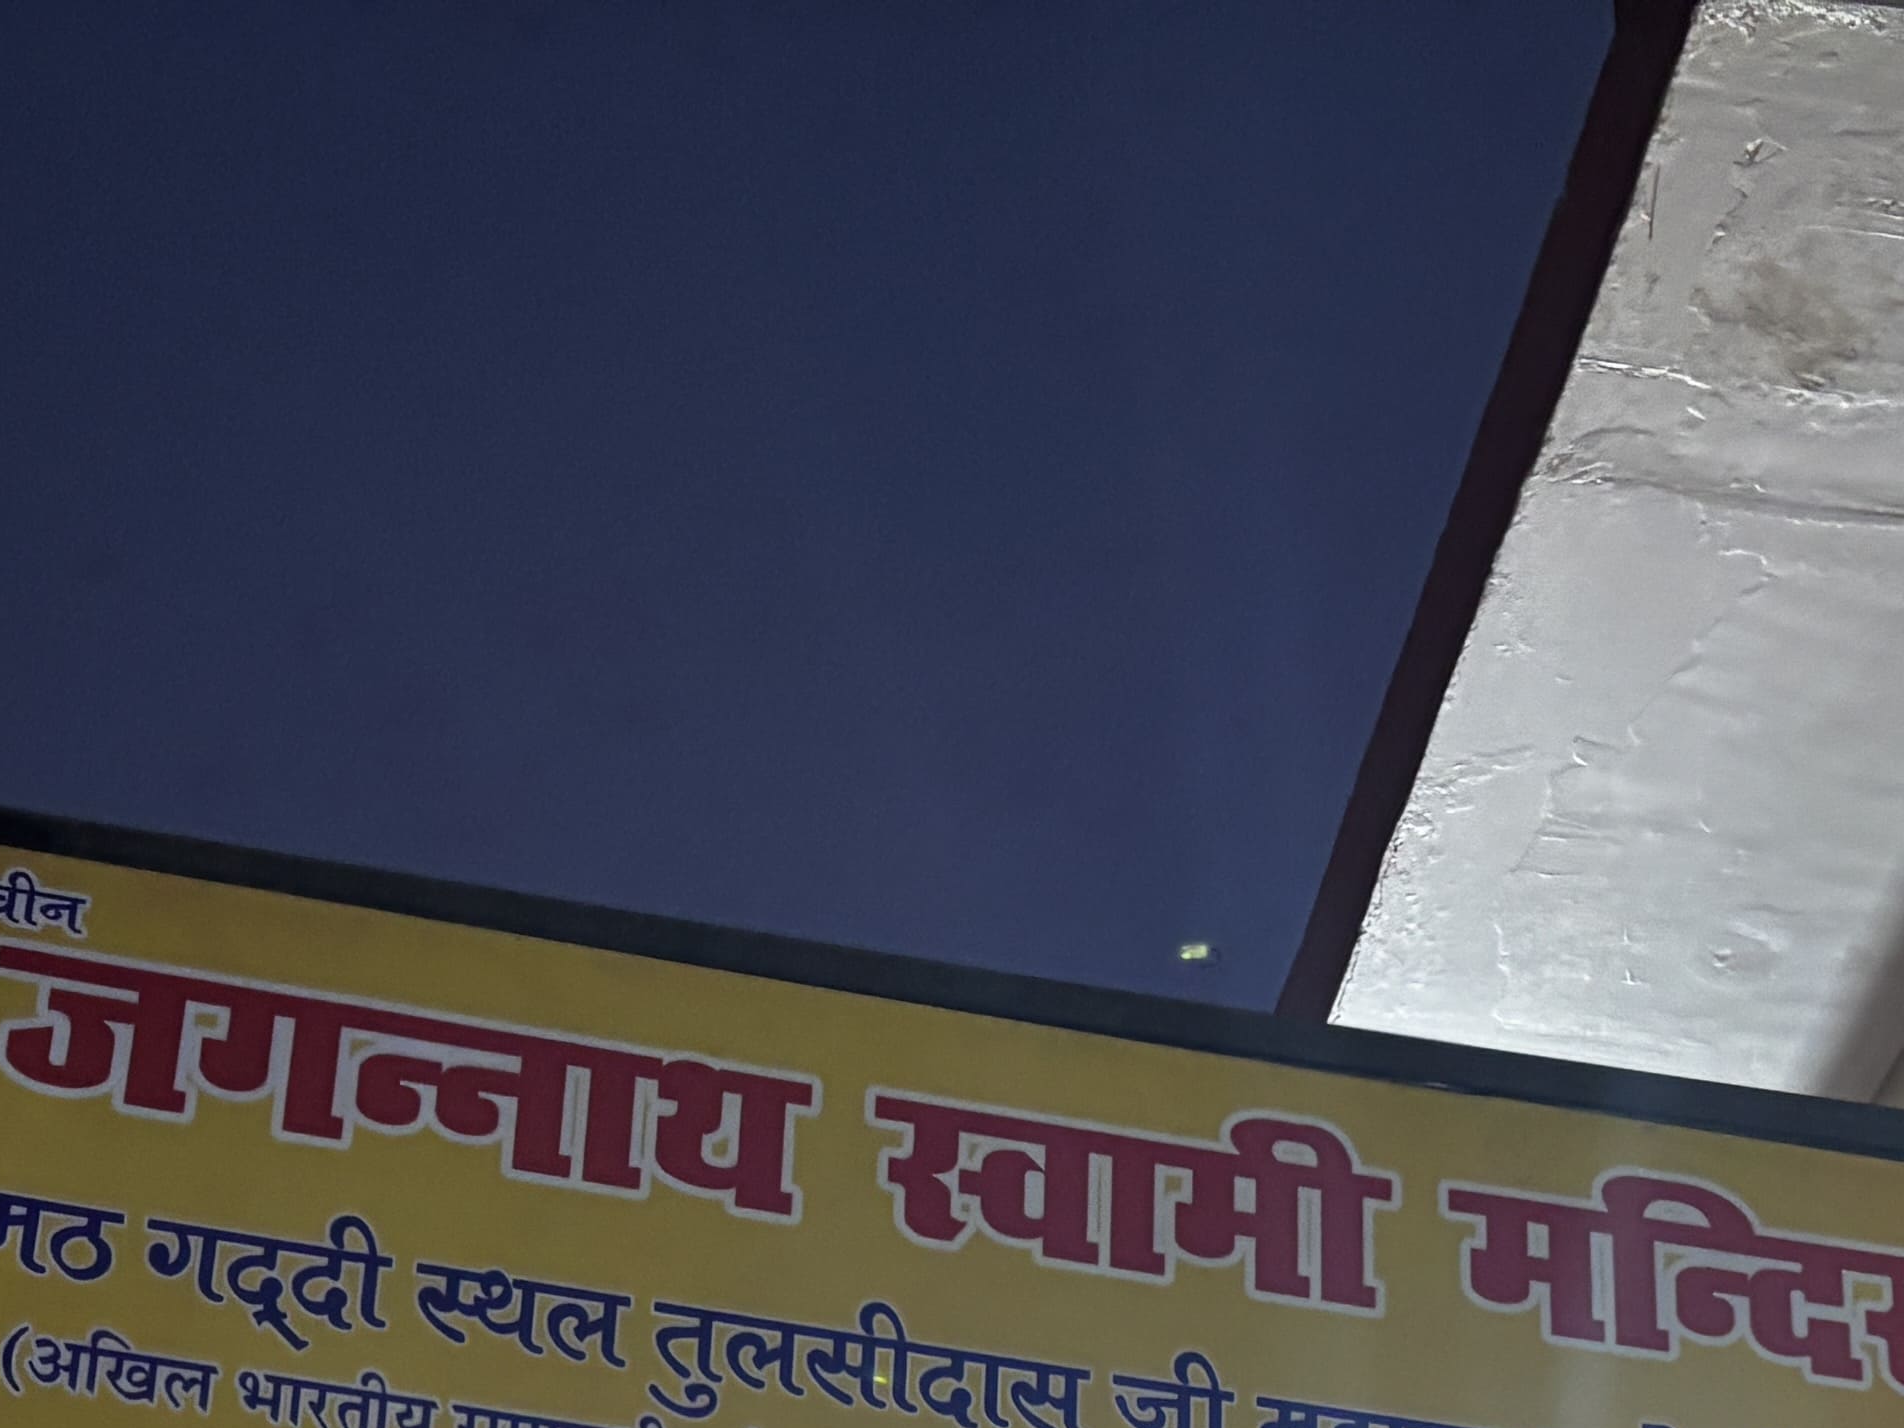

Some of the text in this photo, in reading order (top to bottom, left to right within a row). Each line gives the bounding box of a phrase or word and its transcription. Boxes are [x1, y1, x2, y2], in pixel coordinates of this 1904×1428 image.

[875, 1095, 1393, 1310] स्वामी
[417, 1262, 630, 1368] स्थल
[1, 1326, 217, 1414] (अखिल
